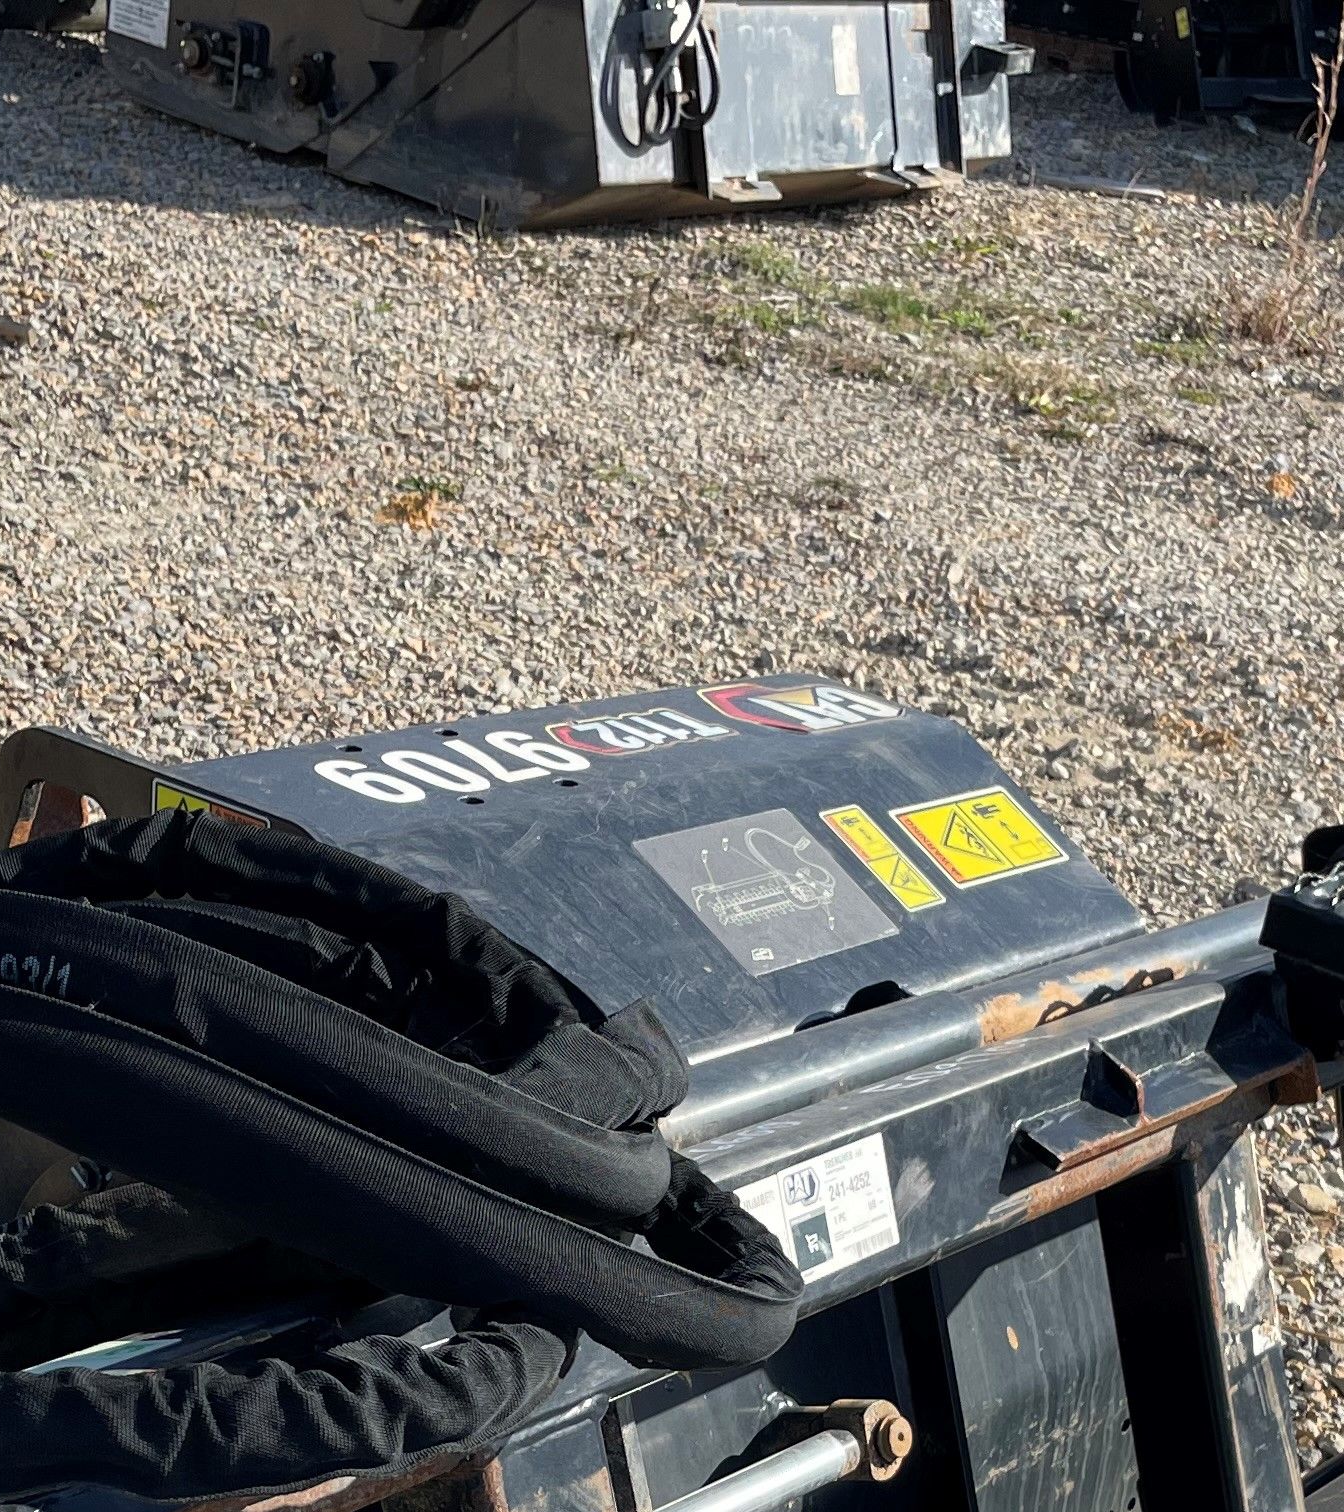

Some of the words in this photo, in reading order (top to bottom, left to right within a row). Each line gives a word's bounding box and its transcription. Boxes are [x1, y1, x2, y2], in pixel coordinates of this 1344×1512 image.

[748, 685, 902, 730] CAT
[574, 710, 730, 751] T112
[314, 730, 591, 804] 9709
[827, 1170, 872, 1201] 241-4252
